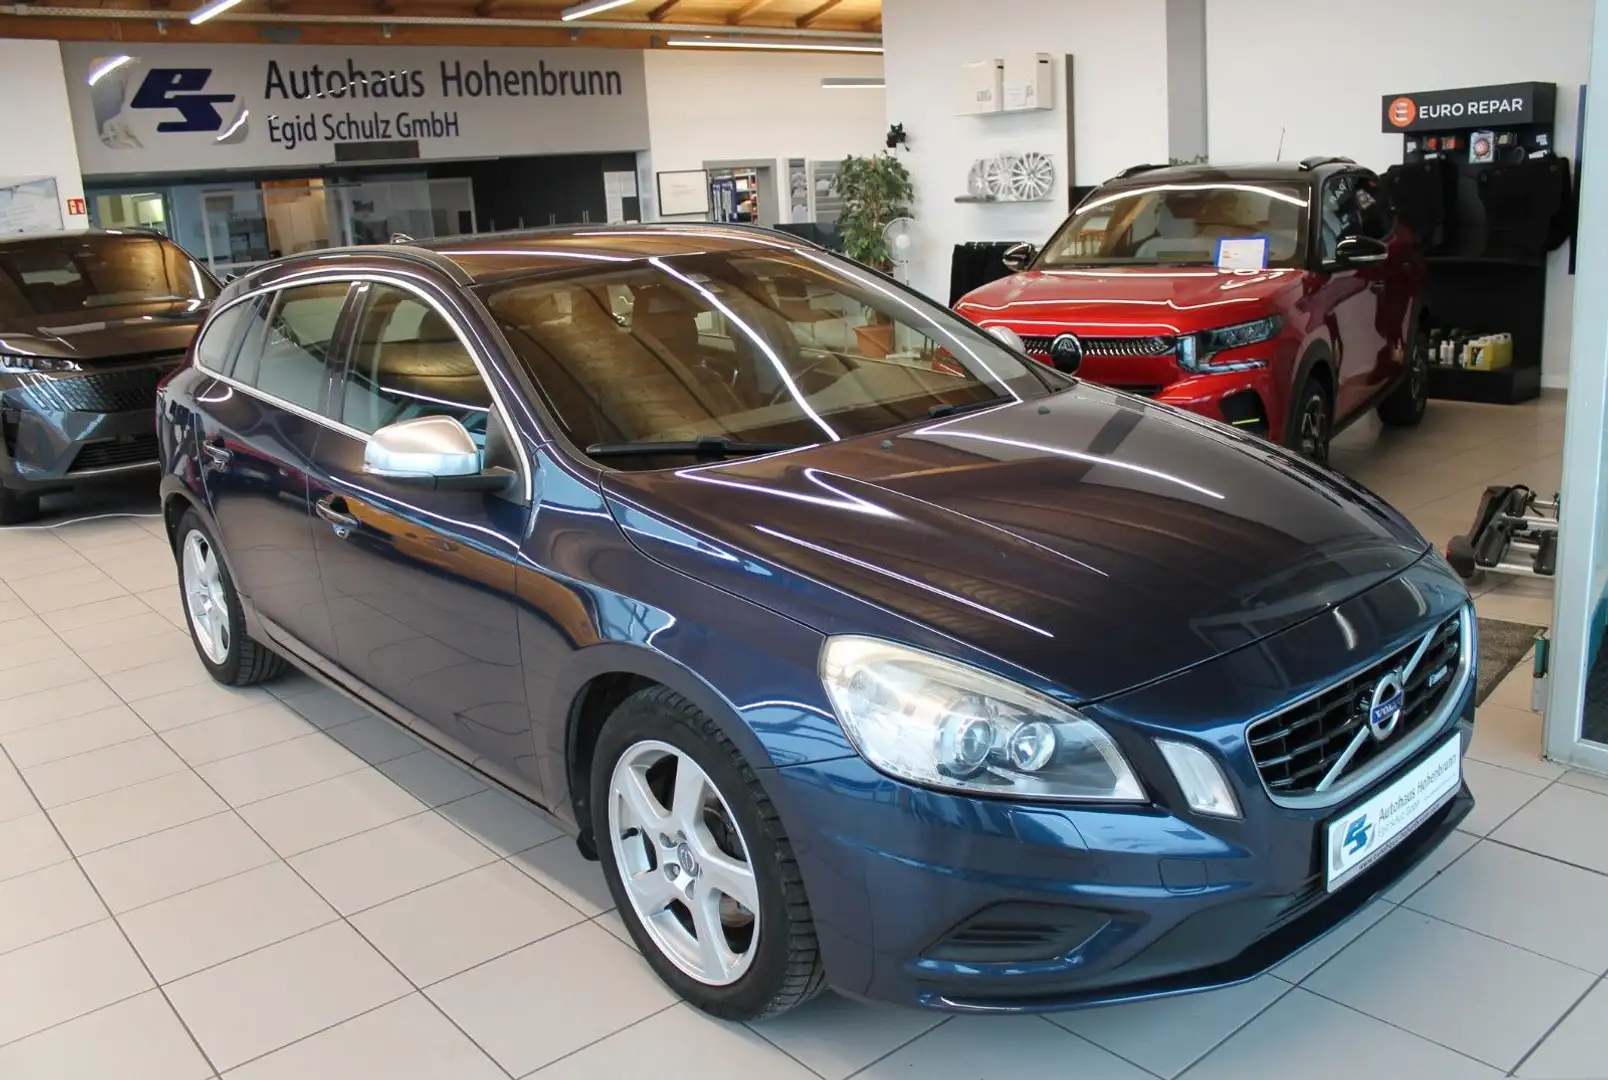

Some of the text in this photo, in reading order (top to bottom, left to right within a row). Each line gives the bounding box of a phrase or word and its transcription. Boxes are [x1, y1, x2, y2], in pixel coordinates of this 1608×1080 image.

[264, 58, 622, 99] Autohaus Hohenbrunn
[1419, 103, 1464, 118] EURO
[1468, 98, 1523, 115] REPAR
[268, 111, 459, 150] Egid Schulz GmbH
[1378, 788, 1416, 821] Autohaus
[1416, 754, 1457, 795] Hohenbrunn
